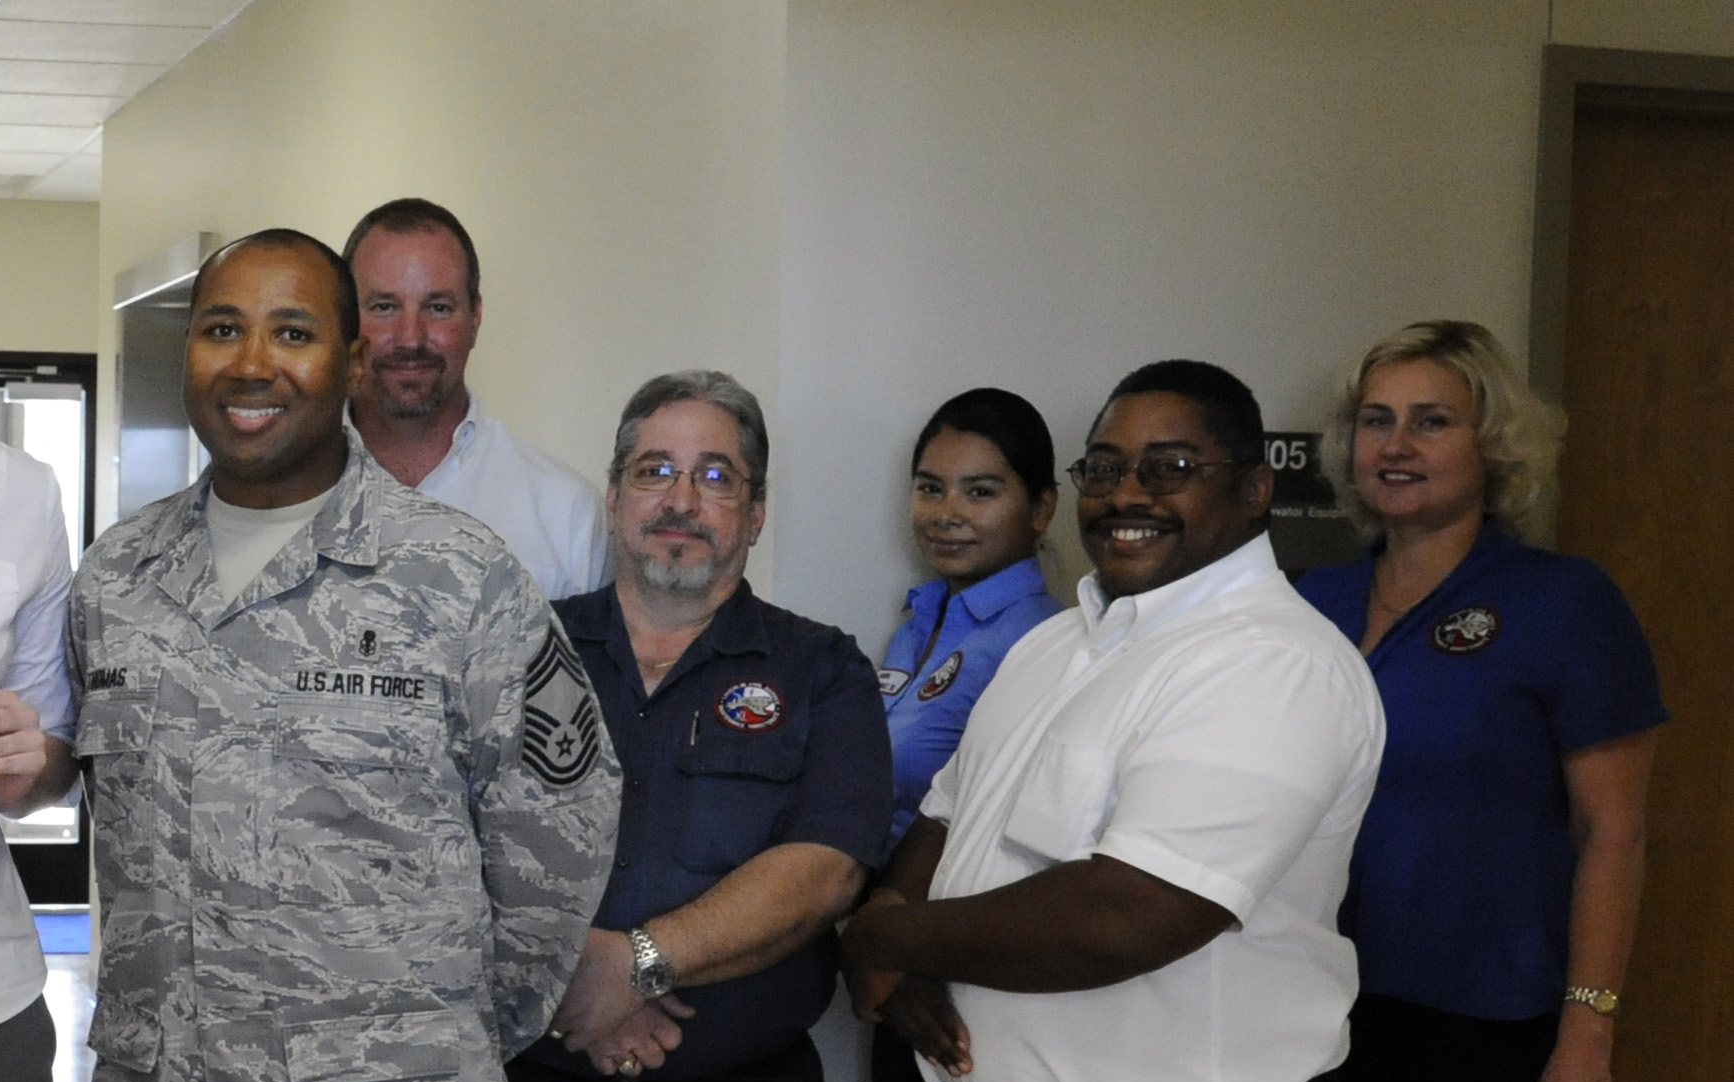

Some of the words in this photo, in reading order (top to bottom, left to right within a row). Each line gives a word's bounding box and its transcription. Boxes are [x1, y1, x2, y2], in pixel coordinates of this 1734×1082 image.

[296, 671, 330, 692] U.S.
[331, 673, 365, 695] AIR
[369, 675, 425, 699] FORCE
